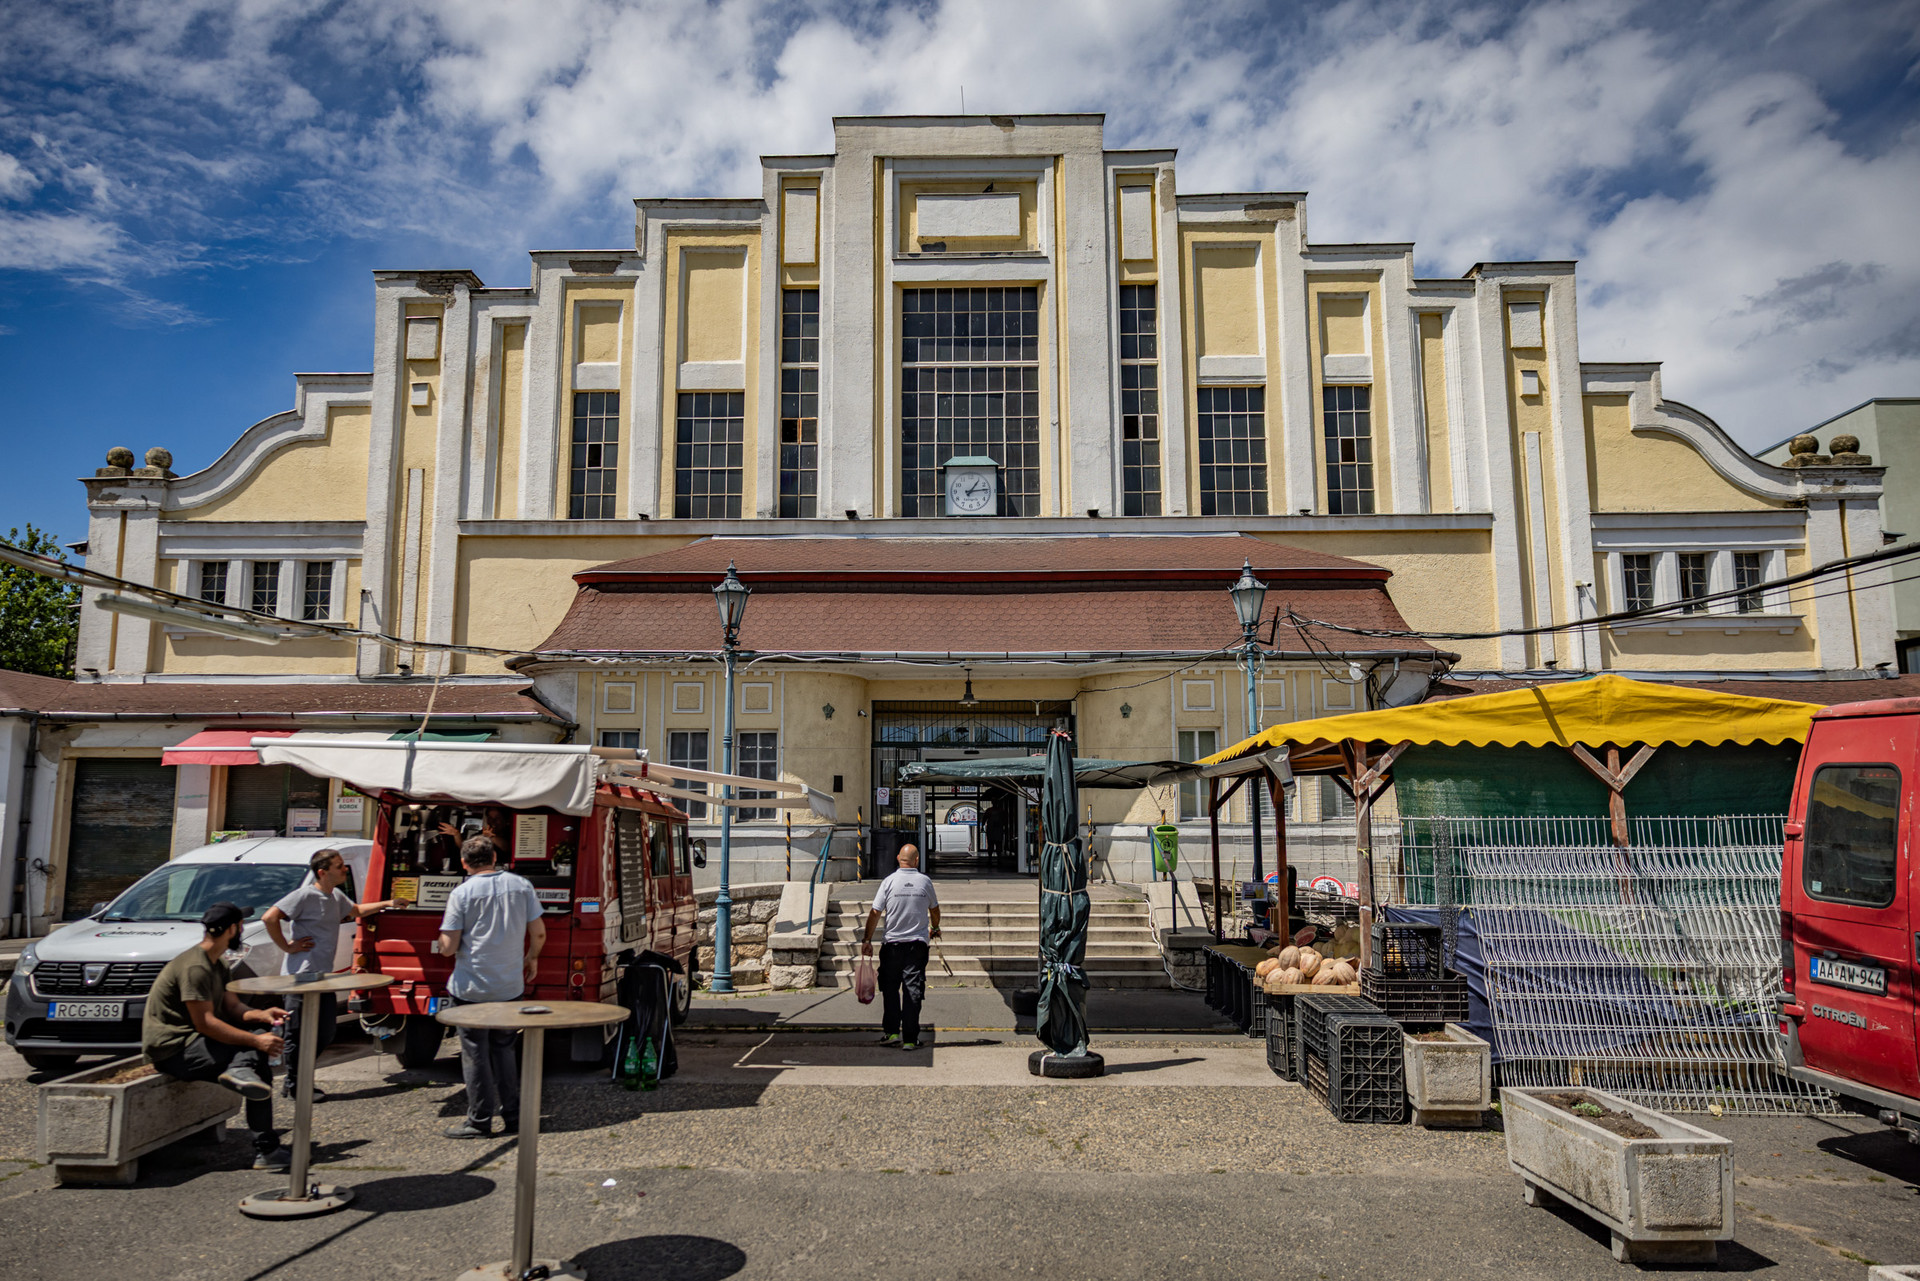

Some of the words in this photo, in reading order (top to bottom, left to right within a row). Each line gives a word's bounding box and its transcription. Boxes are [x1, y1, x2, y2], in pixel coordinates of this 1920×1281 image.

[1819, 961, 1834, 979] AA
[1839, 965, 1883, 988] AW-944
[57, 1004, 120, 1017] RCG-369
[1811, 1004, 1867, 1030] CITROËN
